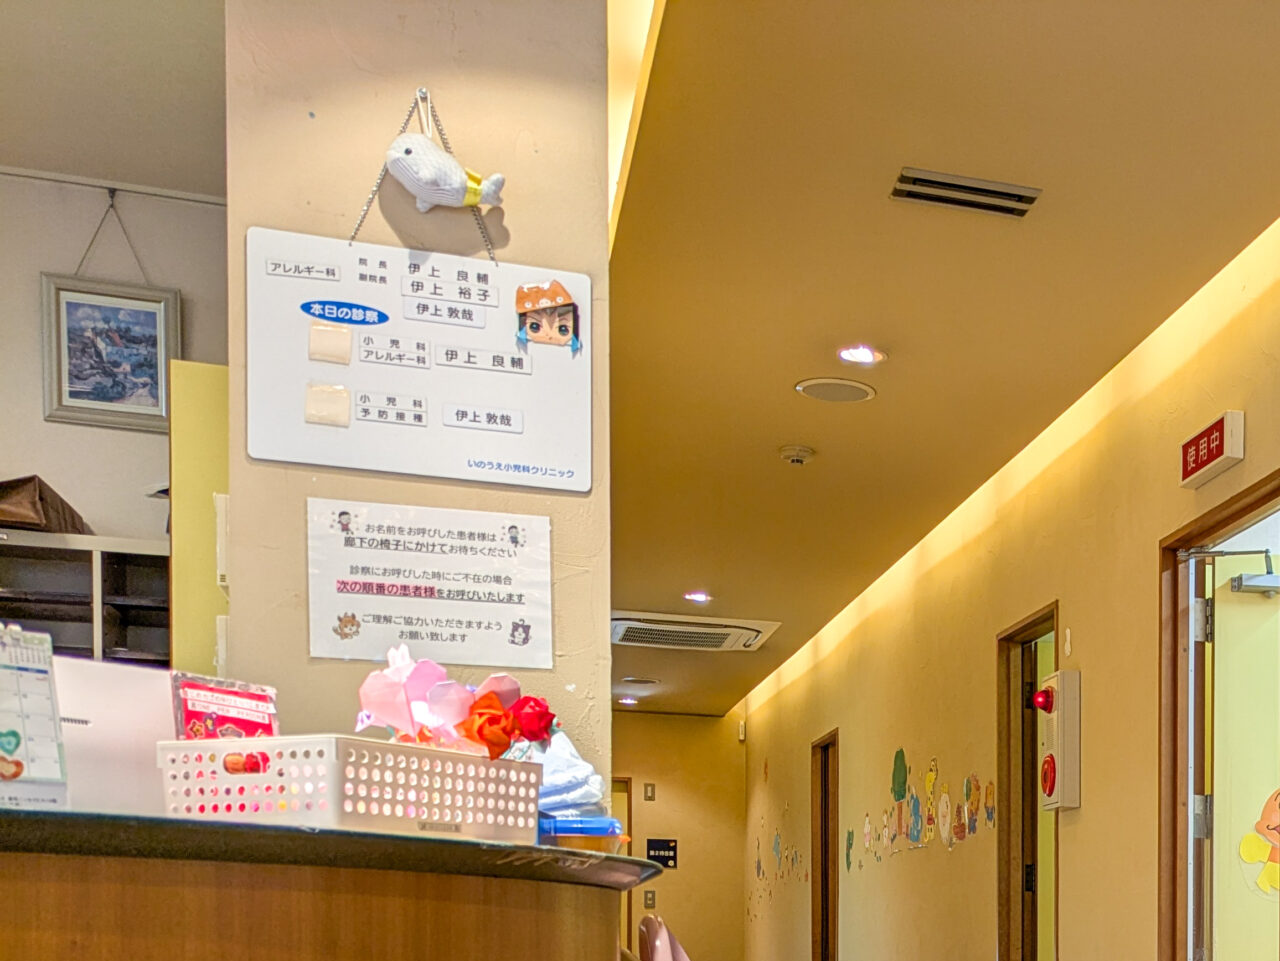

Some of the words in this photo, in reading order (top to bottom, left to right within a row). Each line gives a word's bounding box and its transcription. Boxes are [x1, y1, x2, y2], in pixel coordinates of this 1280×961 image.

[270, 262, 336, 278] アレルギー科
[310, 303, 379, 324] 本日の診察
[363, 349, 426, 366] アレルギー科
[1186, 429, 1221, 471] 使用中
[467, 458, 575, 480] いのうえ小児科クリニック
[364, 524, 497, 543] お名前をお呼びした患者様は
[343, 536, 517, 558] 廊下の椅子にかけてお待ちください
[350, 565, 513, 586] 診察にお呼びした時にご不在の場合
[337, 580, 526, 603] 次の順番の患者様をお呼びいたします
[361, 614, 503, 631] ご理解ご協力いただきますよう
[398, 630, 468, 643] お願い致します
